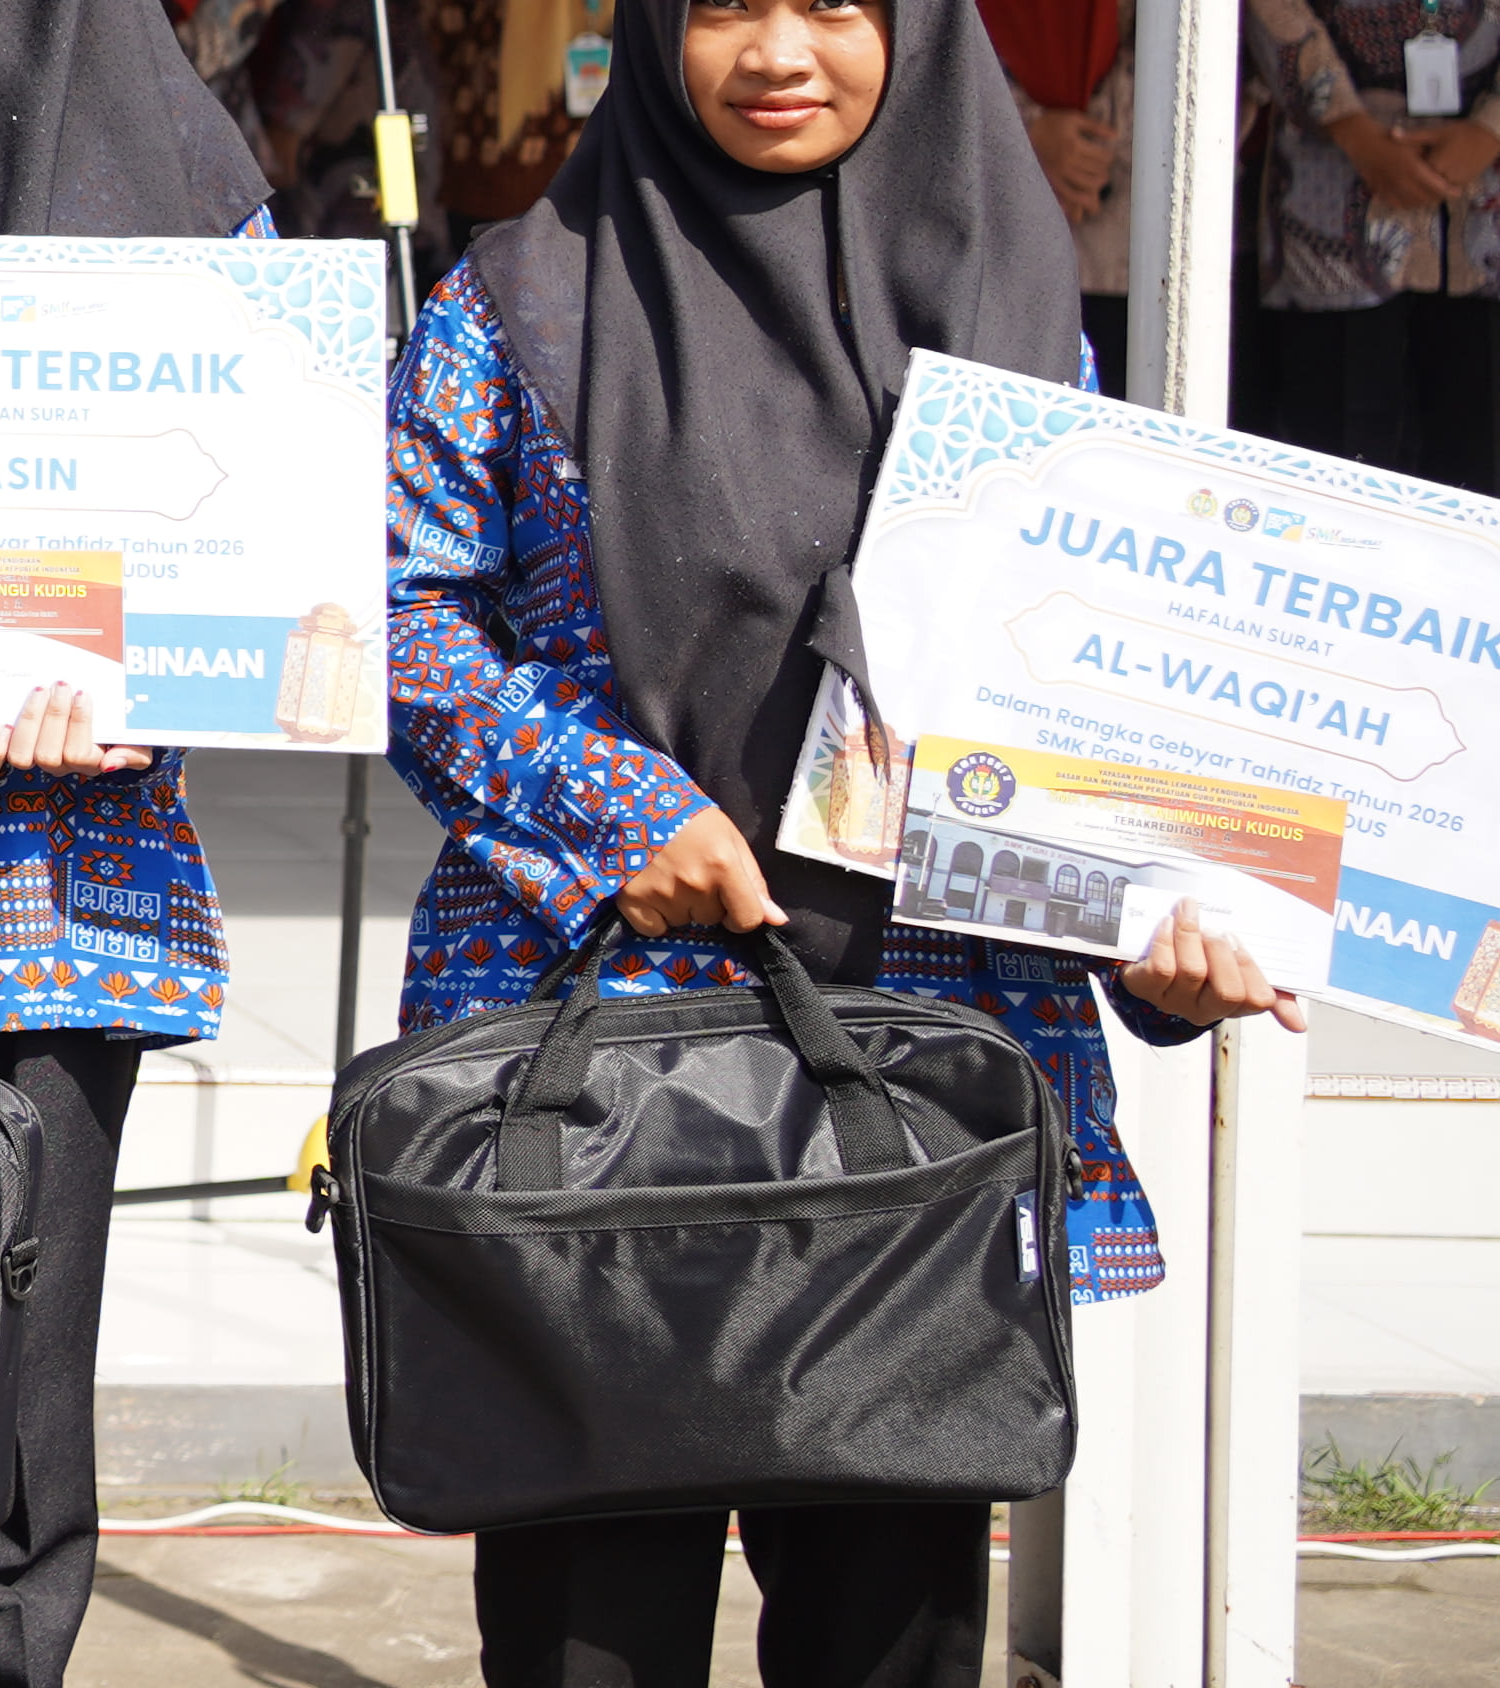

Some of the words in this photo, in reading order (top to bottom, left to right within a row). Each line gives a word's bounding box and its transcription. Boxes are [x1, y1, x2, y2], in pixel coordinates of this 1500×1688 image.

[0, 348, 245, 394] TERBAIK
[29, 406, 89, 422] SURAT
[34, 533, 114, 553] Tahfidz
[118, 536, 190, 556] Tahun
[194, 538, 244, 556] 2026
[123, 562, 181, 580] UDUS
[1018, 506, 1226, 596] JUARA
[1242, 560, 1500, 671] TERBAIK
[33, 584, 89, 599] KUDUS
[1167, 601, 1263, 638] HAFALAN
[1266, 627, 1335, 657] SURAT
[125, 646, 266, 680] BINAAN
[975, 685, 1051, 720] Dalam
[1055, 706, 1144, 745] Rangka
[1145, 731, 1237, 774] Gebyar
[1239, 756, 1324, 794] Tahfidz
[1327, 781, 1407, 819] Tahun
[1407, 803, 1464, 832] 2026
[1035, 728, 1085, 755] SMK
[1341, 811, 1390, 841] DUS
[1054, 771, 1082, 783] DASAR
[1081, 775, 1100, 786] DAN
[1142, 784, 1188, 800] PERSATUAN
[1186, 791, 1211, 803] GURU
[1211, 795, 1255, 810] REPUBLIK
[1255, 802, 1301, 817] INDONESIA
[1097, 769, 1134, 783] YAYASAN
[1133, 774, 1170, 788] PEMBINA
[1169, 780, 1210, 794] LEMBAGA
[1210, 786, 1259, 802] PENDIDIKAN
[1112, 814, 1207, 839] TERAKREDITASI
[1141, 803, 1243, 833] KALIWUNGU
[1243, 819, 1307, 843] KUDUS
